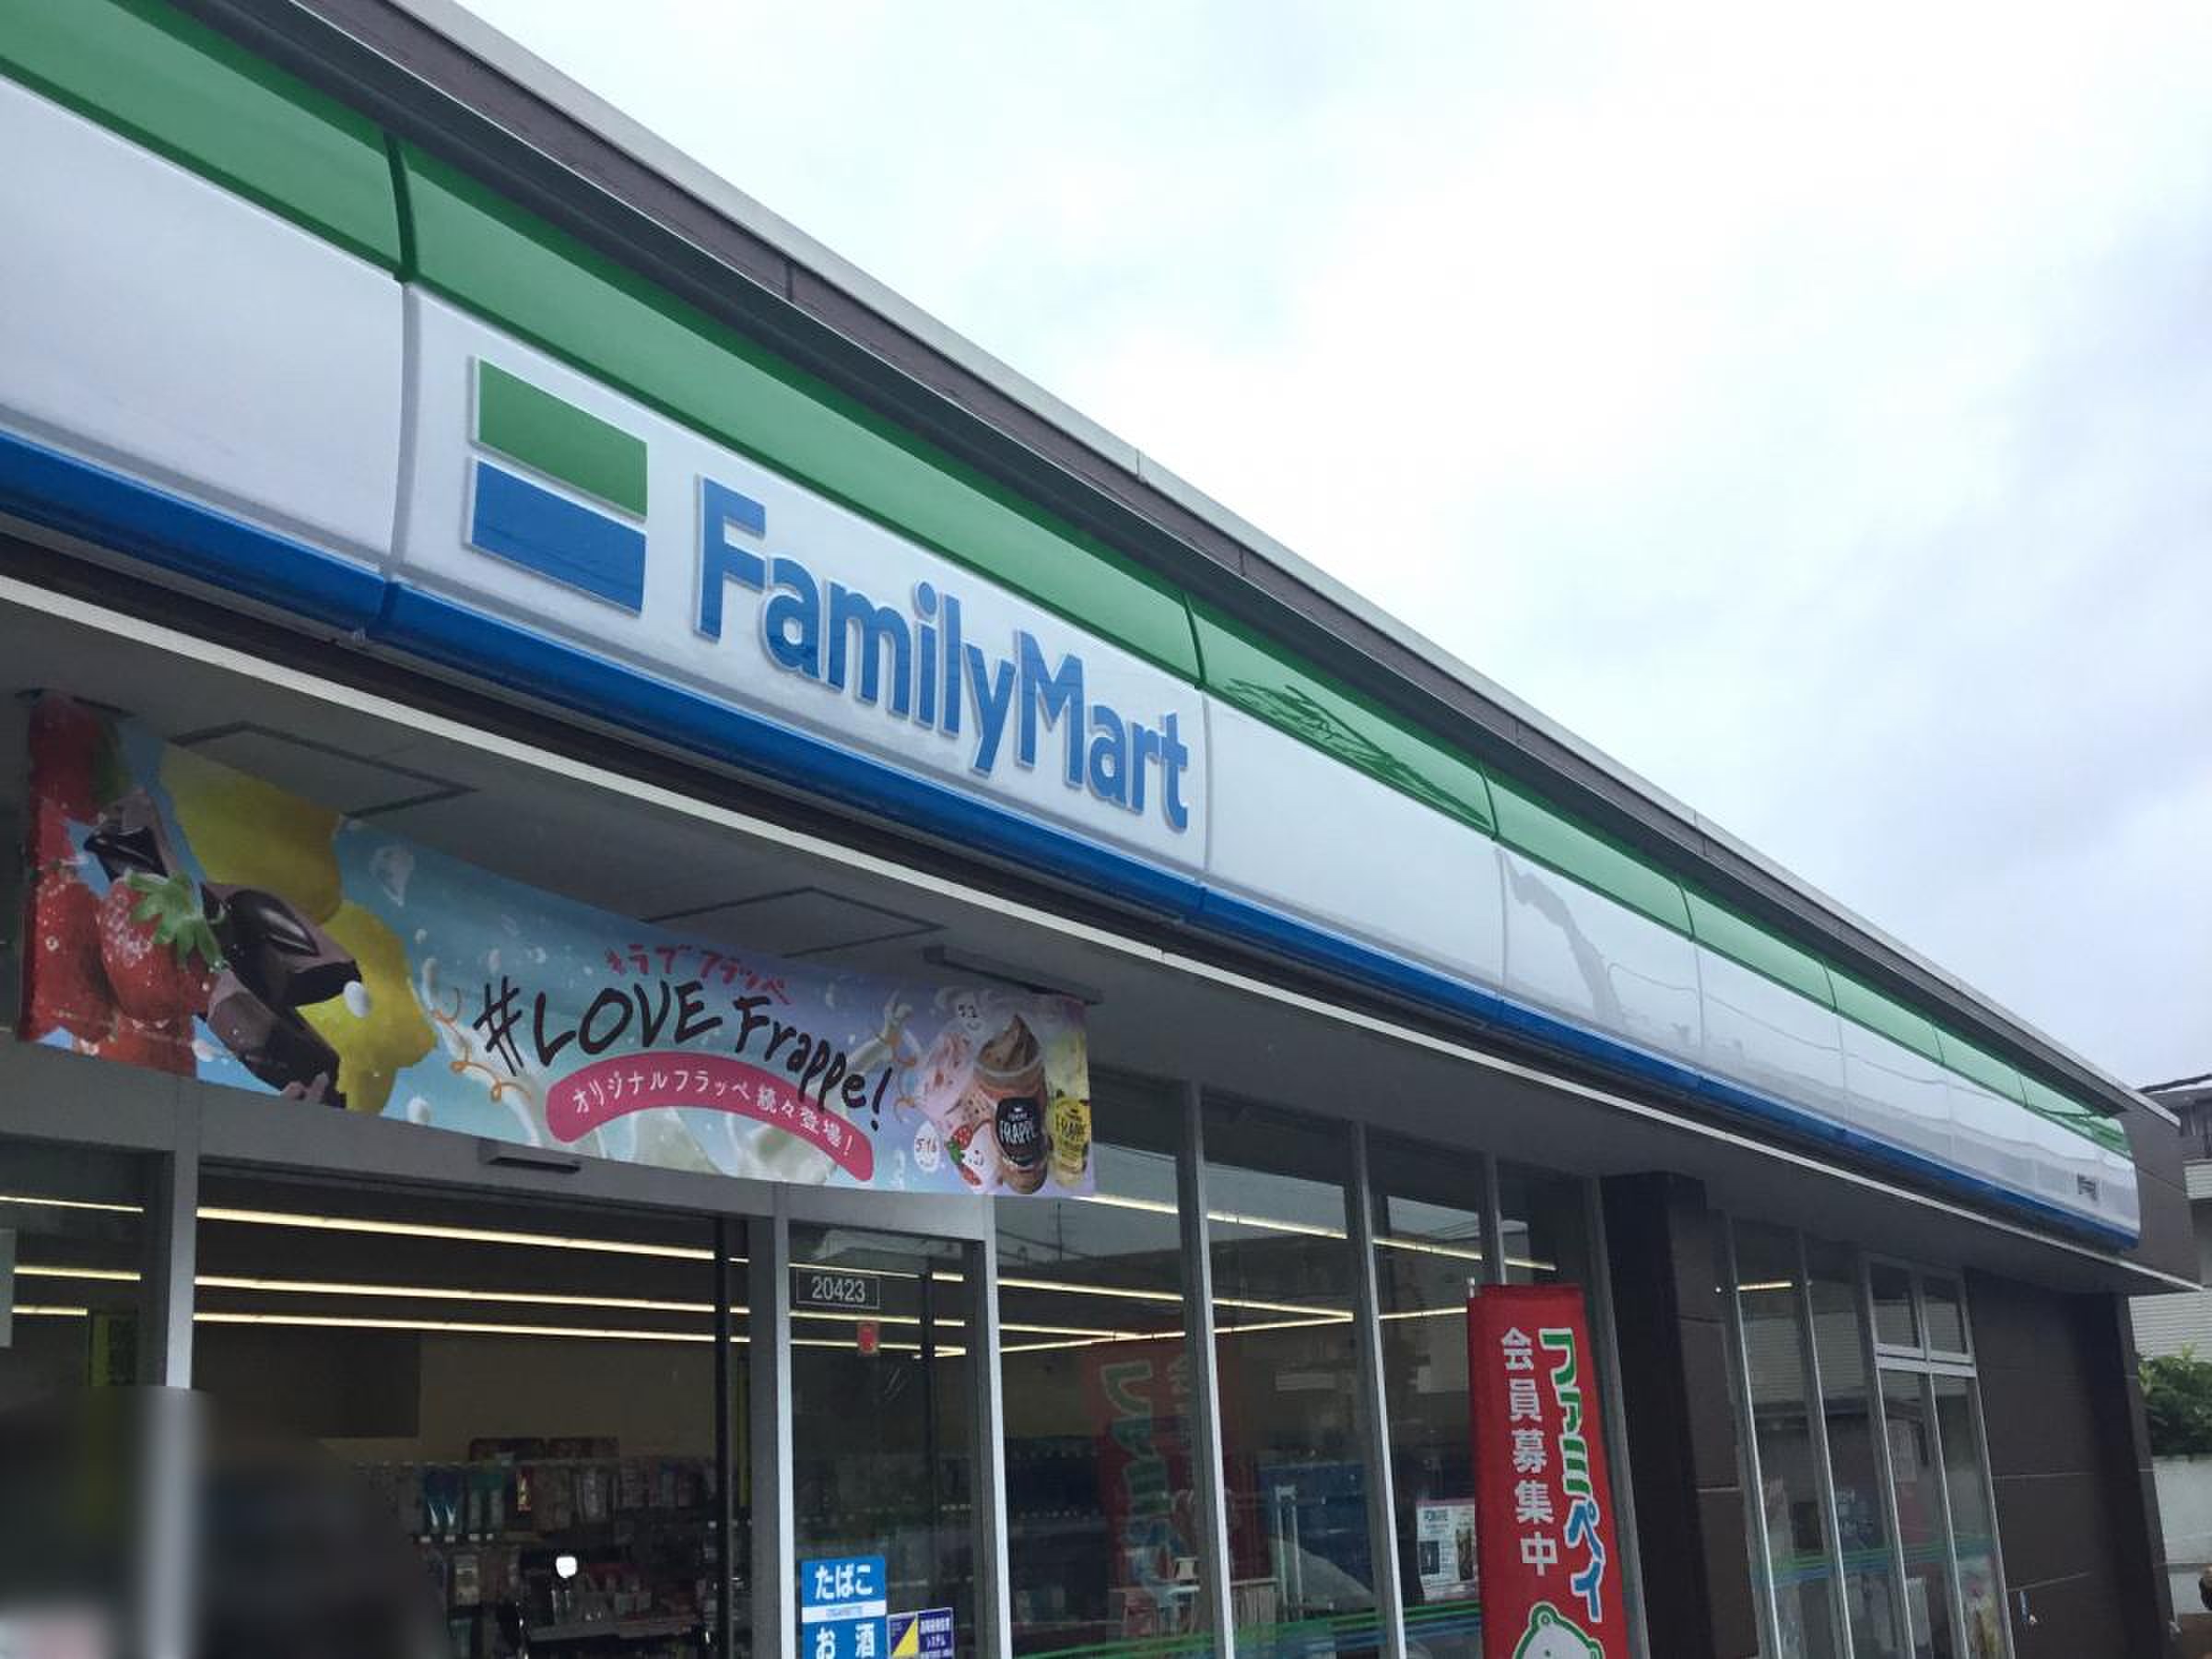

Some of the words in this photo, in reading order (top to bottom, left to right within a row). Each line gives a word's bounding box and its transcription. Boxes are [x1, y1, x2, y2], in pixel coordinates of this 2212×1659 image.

[696, 475, 1188, 830] FamilyMart
[473, 975, 723, 1077] #LOVE
[733, 995, 892, 1132] Frappe!
[811, 1276, 865, 1302] 20423
[1501, 1327, 1558, 1576] 会員募集中
[1539, 1327, 1606, 1622] ファミペイ
[815, 1563, 873, 1600] たばこ
